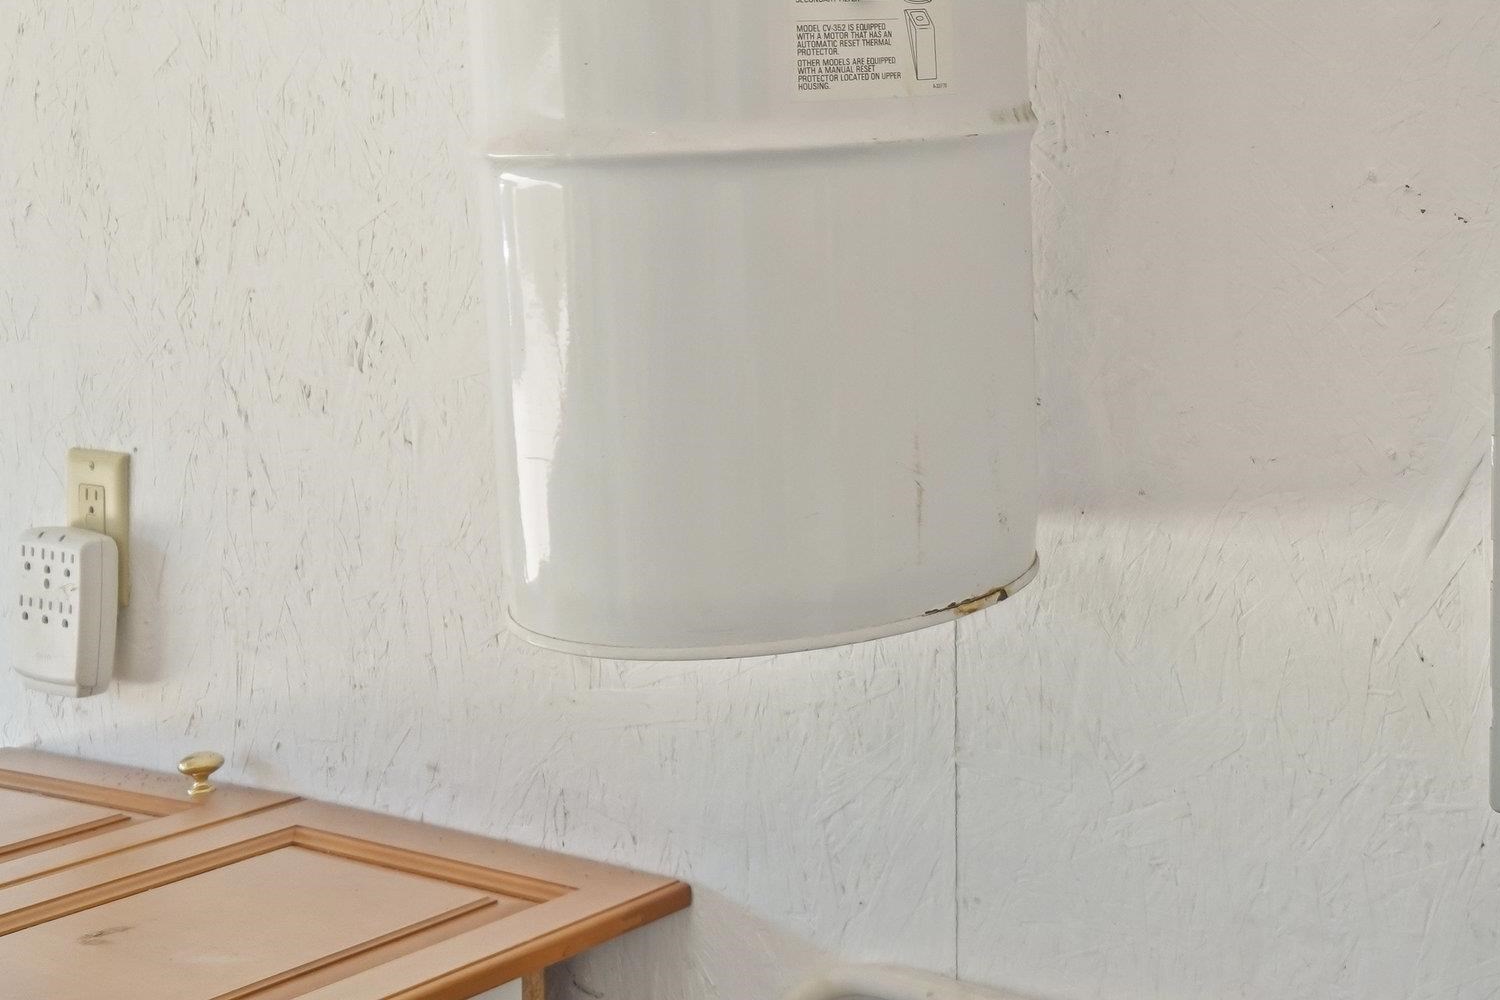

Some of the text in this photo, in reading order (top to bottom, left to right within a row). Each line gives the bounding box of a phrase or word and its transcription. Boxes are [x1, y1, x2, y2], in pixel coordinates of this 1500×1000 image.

[797, 22, 886, 32] MODEL CV-352 IS EQUIPPED
[797, 32, 815, 40] WITH
[823, 31, 849, 40] MOTOR
[851, 31, 867, 39] THAT
[869, 30, 882, 38] HAS
[883, 30, 893, 38] AN
[797, 38, 892, 48] AUTOMATIC RESET THERMAL
[797, 47, 840, 56] PROTECTOR.
[797, 56, 896, 67] OTHER MODELS ARE EQUIPPED
[797, 64, 876, 75] WITH A MANUAL RESET
[798, 71, 902, 83] PROTECTOR LOCATED ON UPPER
[798, 82, 831, 91] HOUSING.
